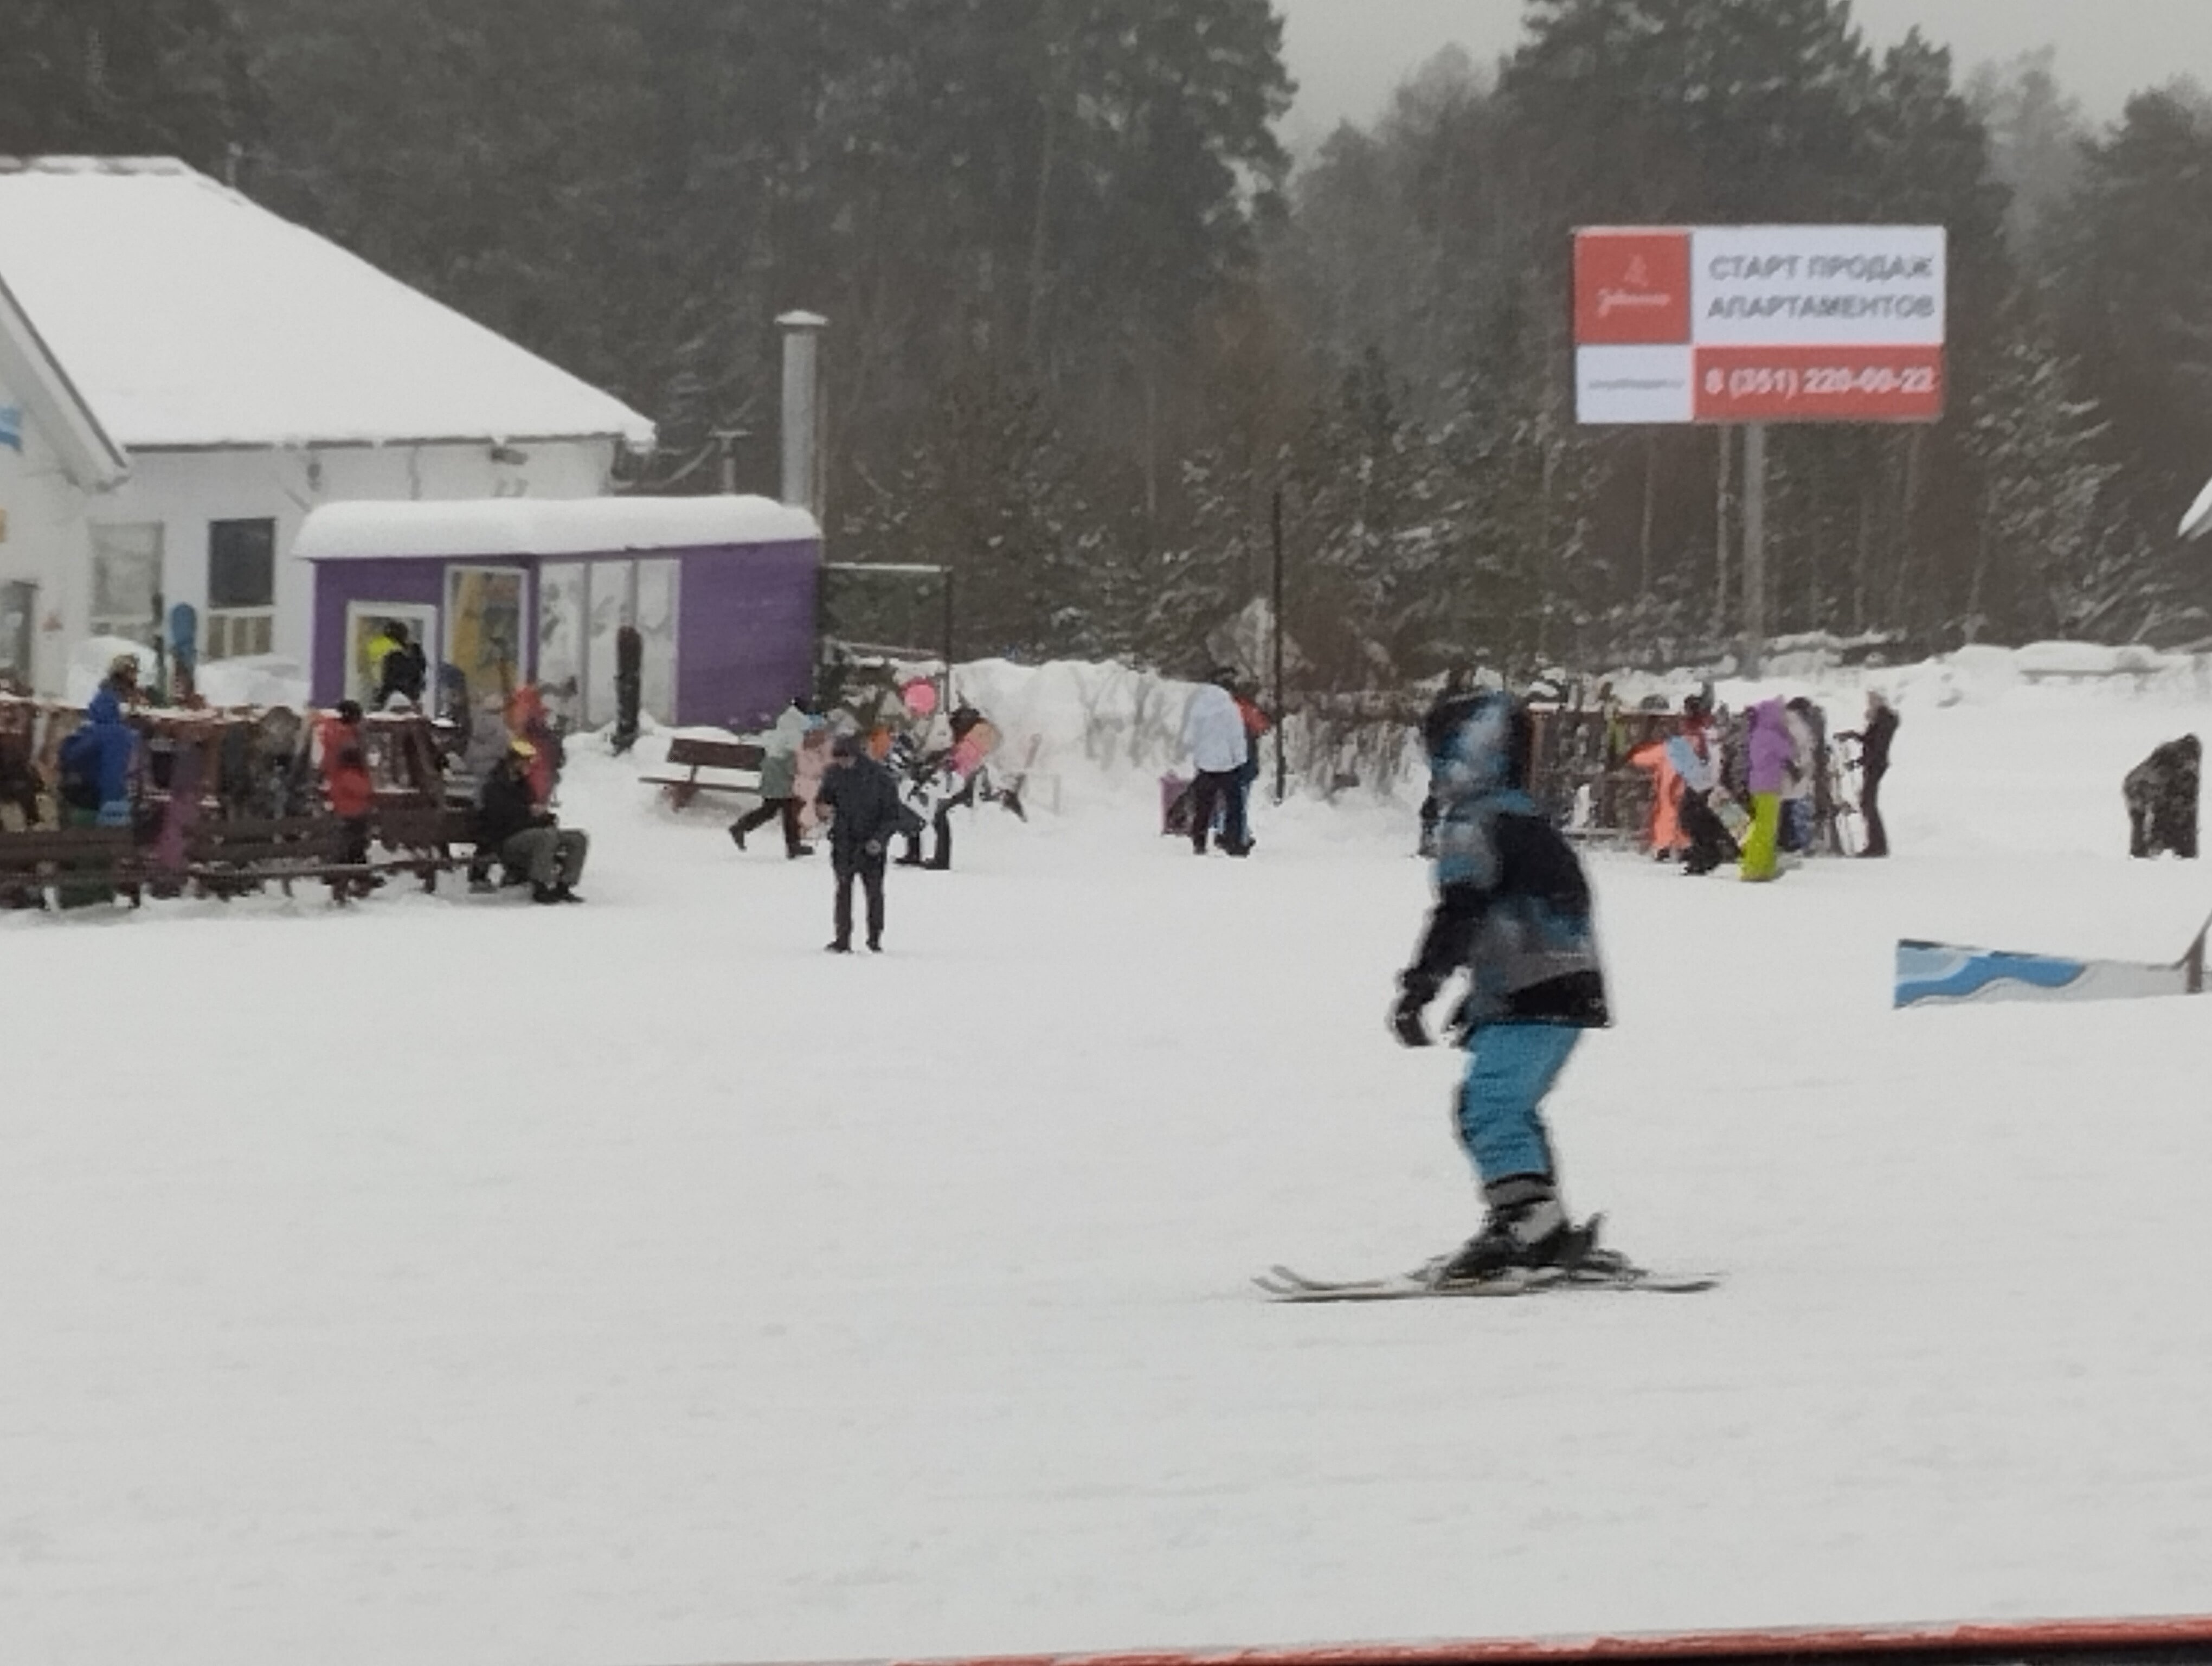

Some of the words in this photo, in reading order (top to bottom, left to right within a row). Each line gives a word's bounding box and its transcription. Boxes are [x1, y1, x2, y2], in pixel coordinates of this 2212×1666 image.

[1708, 254, 1802, 280] СТАРТ
[1806, 254, 1934, 283] ПРОДАЖ
[1706, 294, 1934, 319] АПАРТАМЕНТОВ
[1705, 367, 1724, 394] 8
[1729, 367, 1798, 400] (351)
